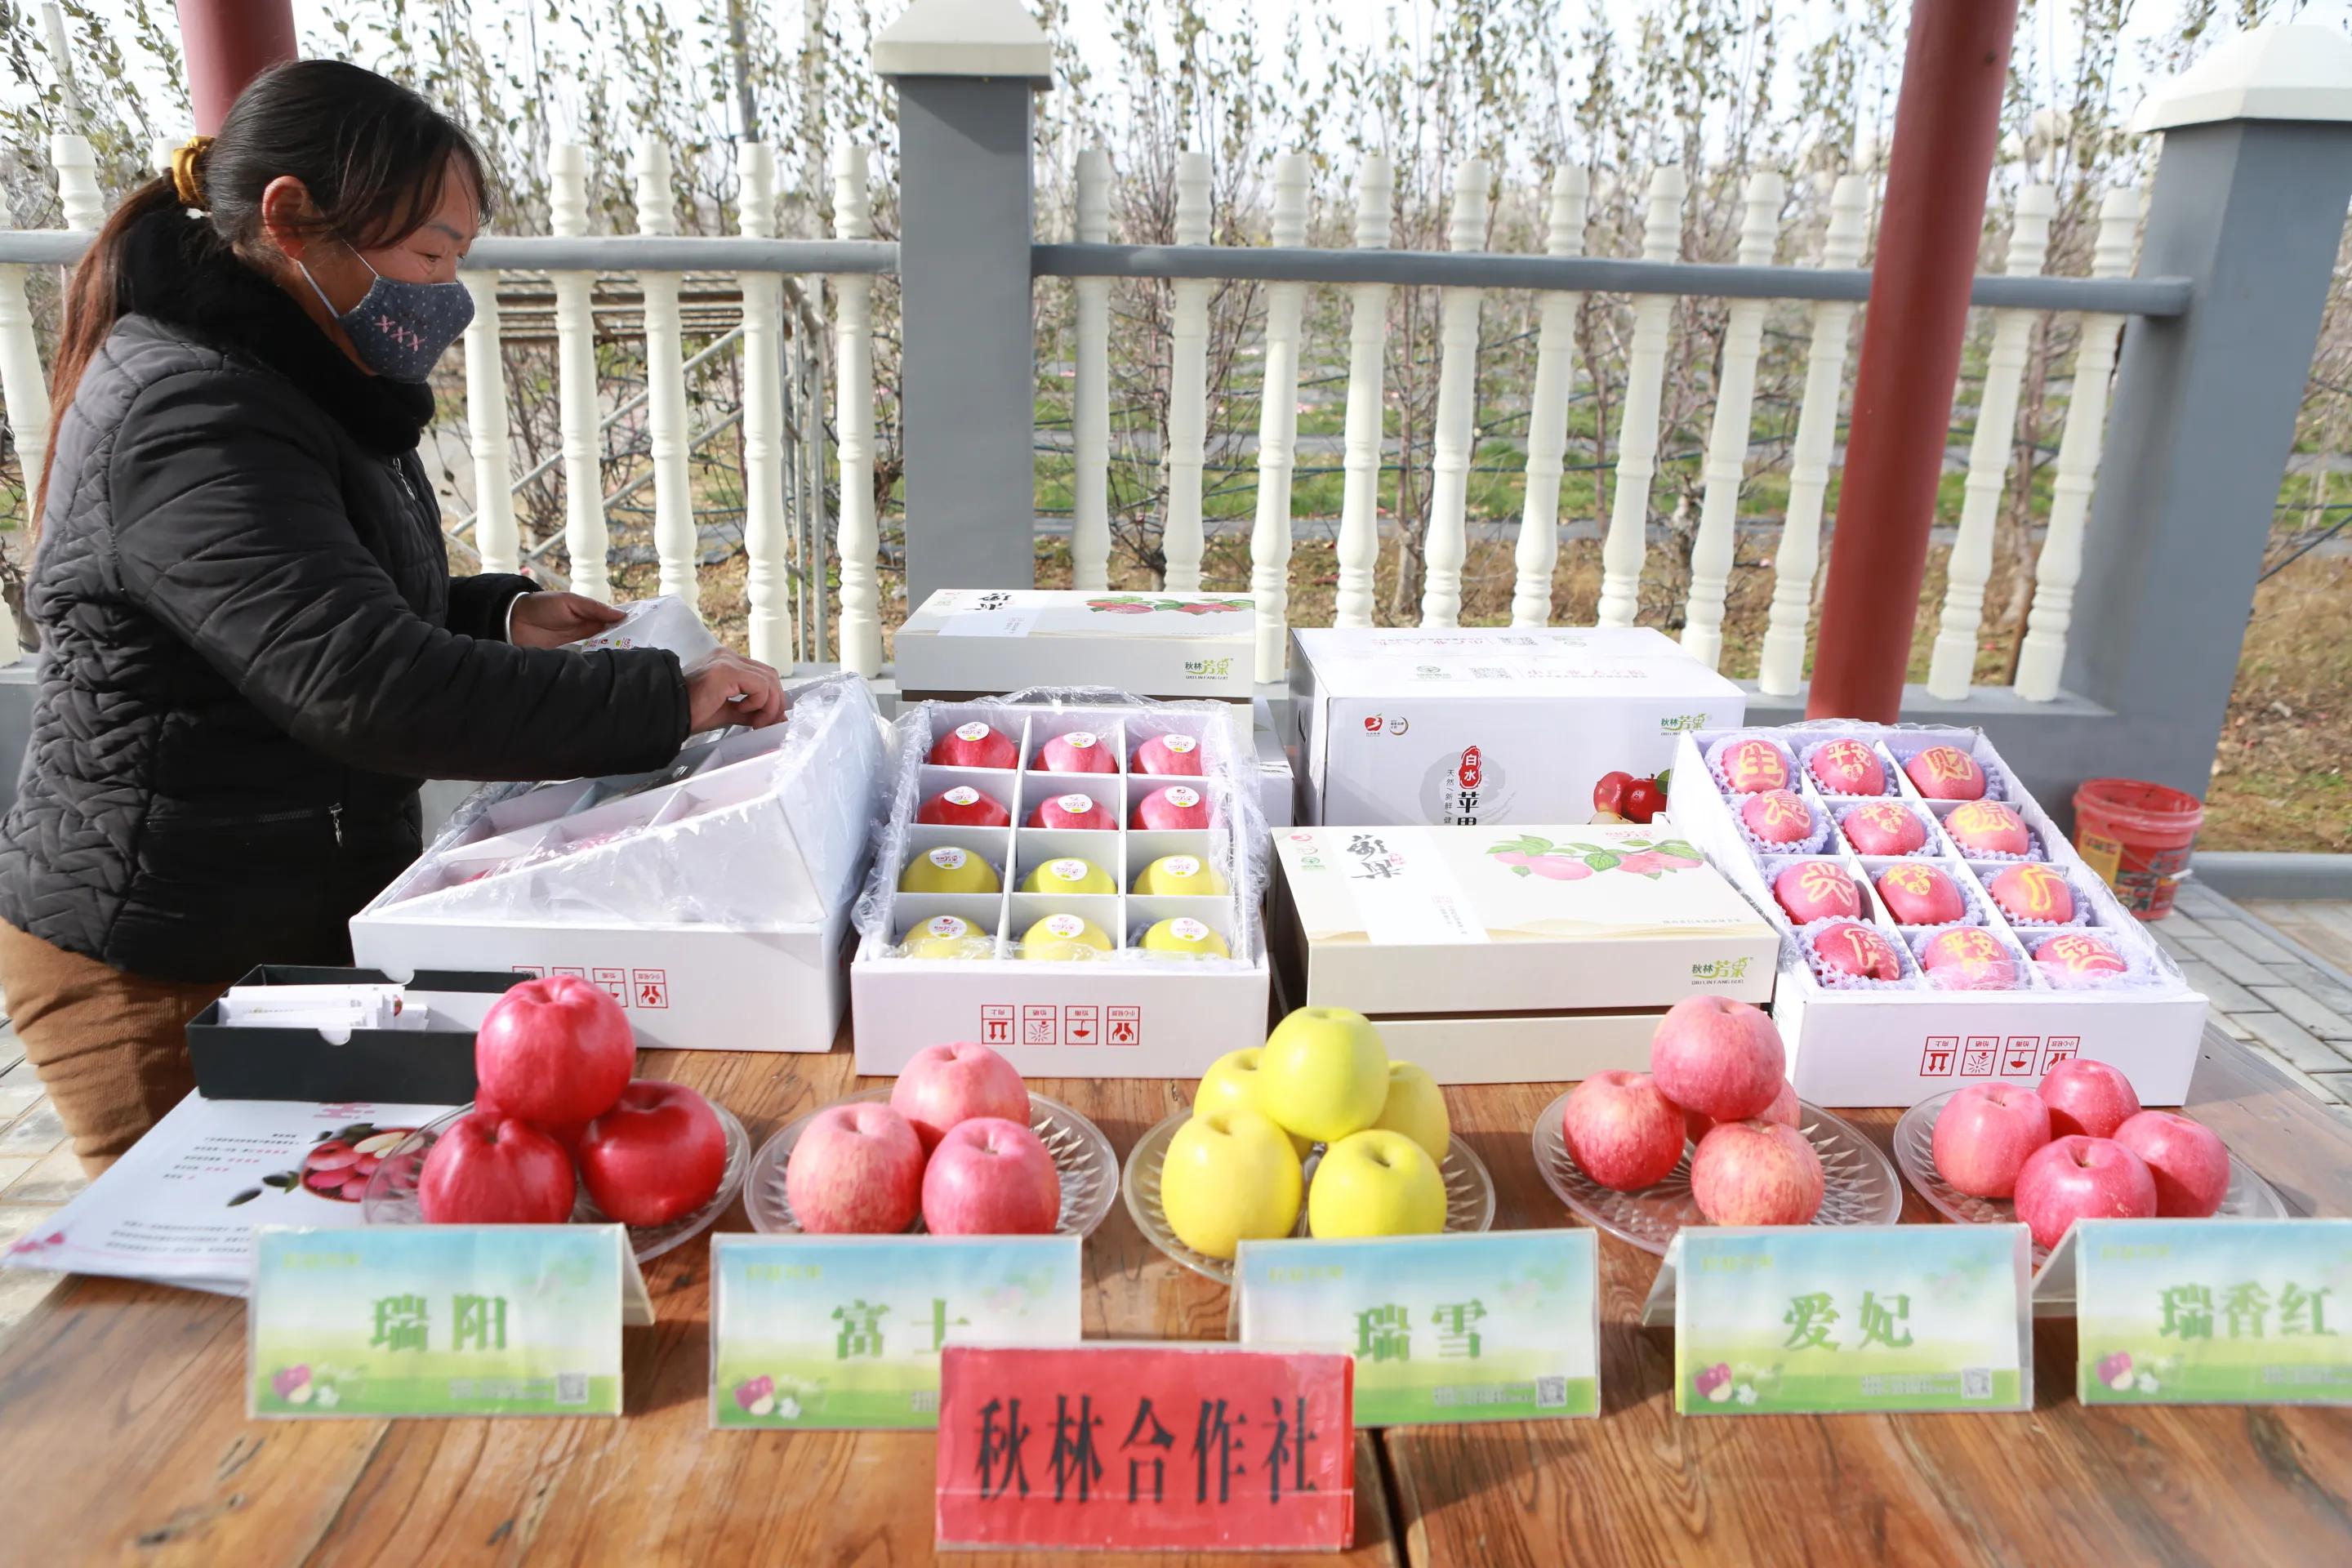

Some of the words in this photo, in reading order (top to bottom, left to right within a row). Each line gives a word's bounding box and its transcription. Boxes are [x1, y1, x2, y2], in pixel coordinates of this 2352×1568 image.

[1464, 754, 1477, 782] 白水
[1737, 742, 1784, 788] 生
[1827, 742, 1872, 767] 平安
[1922, 746, 1973, 783] 财
[1692, 956, 1748, 979] 秋林芳果
[368, 1293, 508, 1353] 瑞阳
[831, 1298, 972, 1361] 富士
[1352, 1298, 1487, 1362] 瑞雪
[1782, 1291, 1914, 1352] 爱妃
[2158, 1280, 2338, 1341] 瑞香红
[973, 1394, 1319, 1504] 秋林合作社
